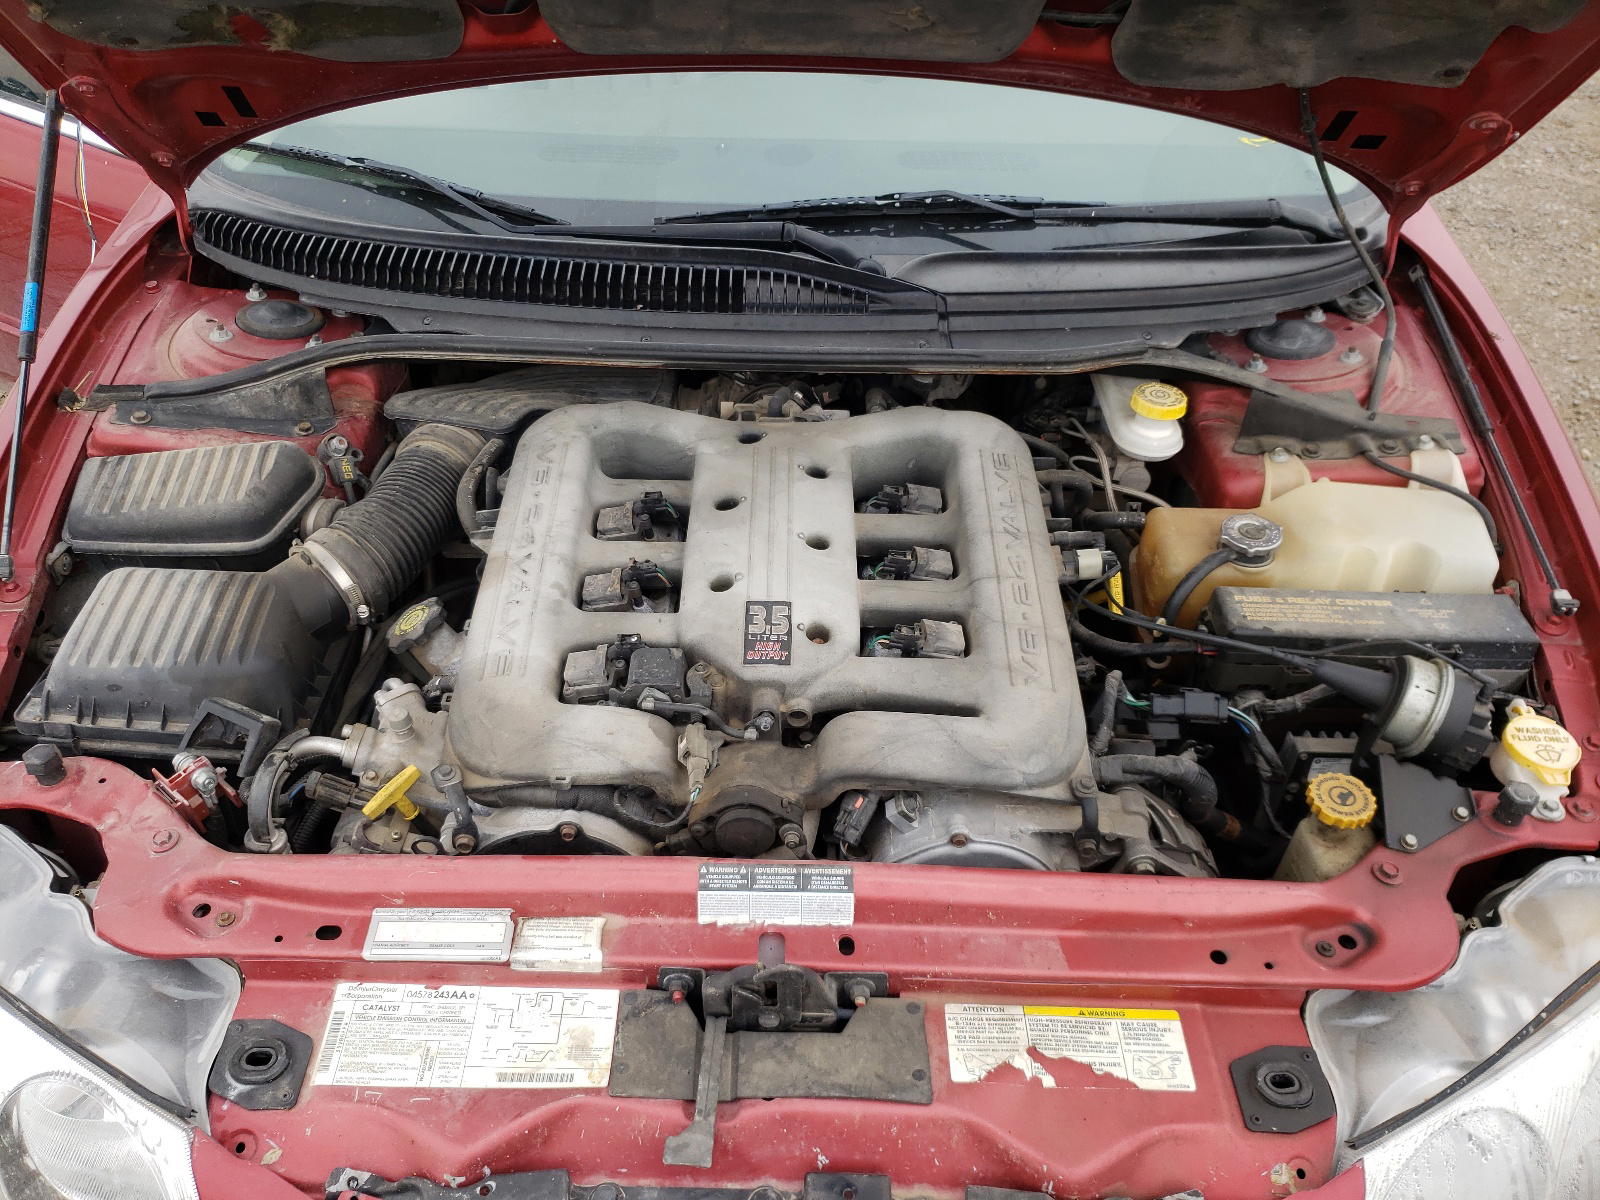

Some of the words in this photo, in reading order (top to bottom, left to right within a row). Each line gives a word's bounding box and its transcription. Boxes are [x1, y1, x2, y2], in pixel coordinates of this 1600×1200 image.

[341, 458, 354, 479] NEG
[1233, 595, 1272, 603] FUSE
[1287, 597, 1331, 605] RELAY
[1335, 598, 1393, 606] CENTER
[748, 605, 790, 635] 3.5
[755, 642, 782, 651] HIGH
[747, 651, 789, 661] OUTPUT
[1513, 727, 1561, 736] WASHER
[1511, 734, 1542, 742] FLUID
[1544, 735, 1570, 743] ONLY
[1087, 1009, 1126, 1017] WARNING
